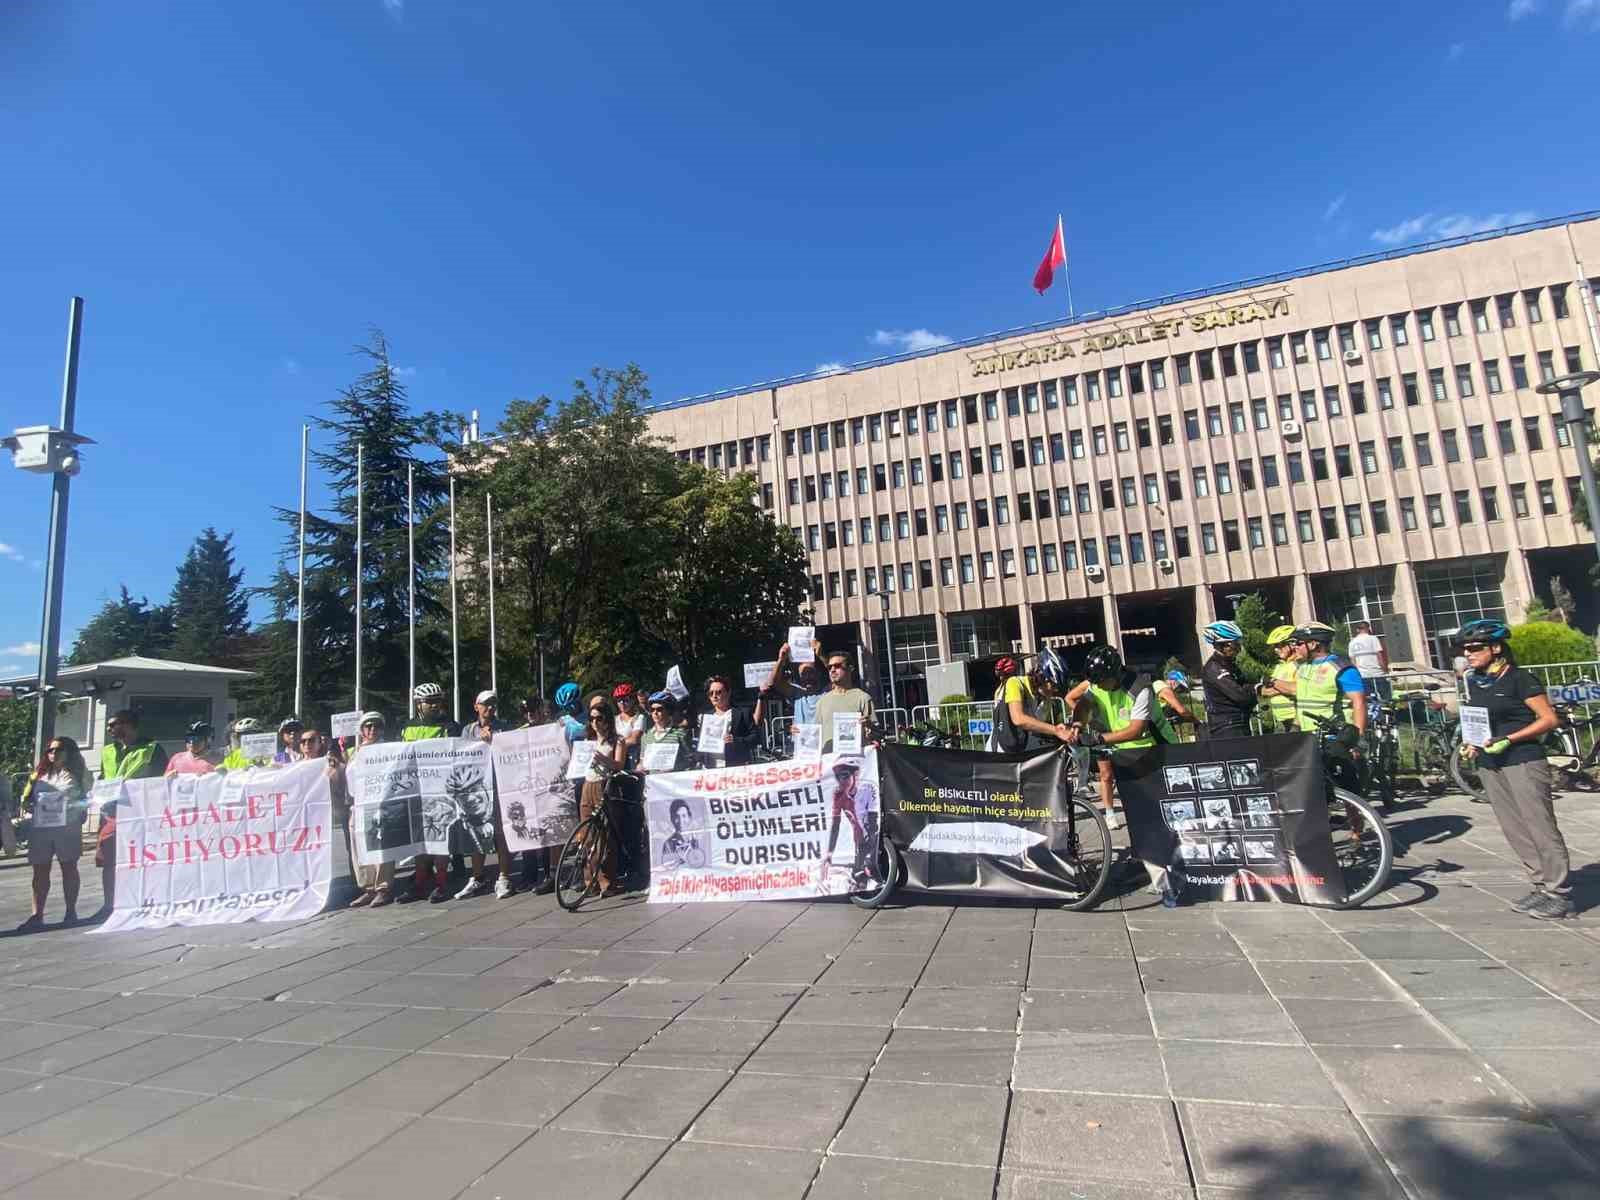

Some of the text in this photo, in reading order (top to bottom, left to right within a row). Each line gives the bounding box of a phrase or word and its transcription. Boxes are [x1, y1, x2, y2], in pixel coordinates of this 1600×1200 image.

[972, 298, 1290, 377] ANKARA ADALET SARAYI
[160, 790, 290, 830] ADALET
[924, 787, 937, 799] Bir
[716, 806, 828, 840] ÖLÜMLERİ
[943, 801, 983, 817] hayatım
[984, 805, 1006, 819] hiçe
[1007, 806, 1052, 820] sayılarak
[127, 824, 322, 870] İSTİYORUZ!
[725, 841, 822, 866] DUR!SUN
